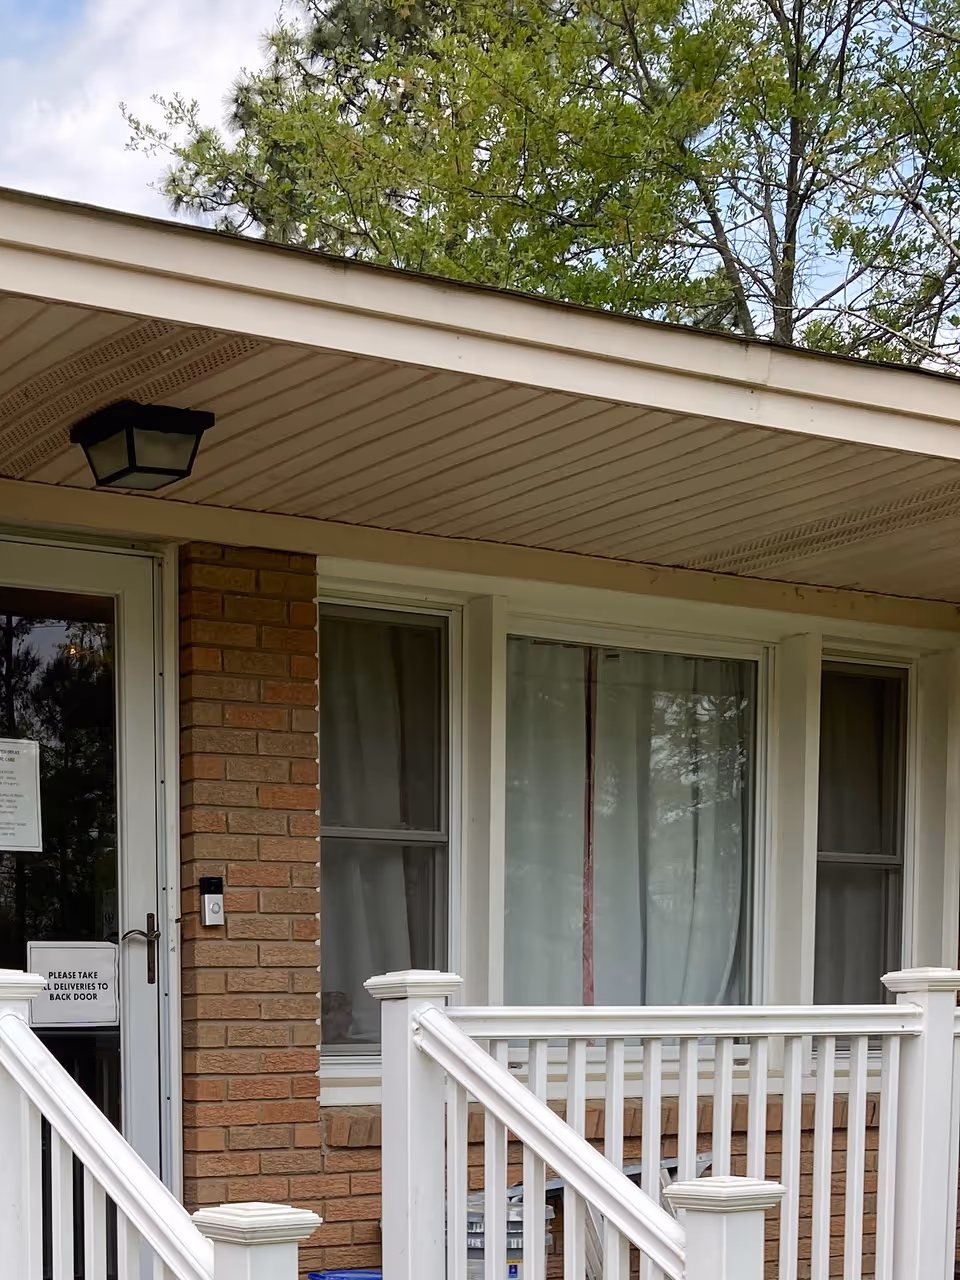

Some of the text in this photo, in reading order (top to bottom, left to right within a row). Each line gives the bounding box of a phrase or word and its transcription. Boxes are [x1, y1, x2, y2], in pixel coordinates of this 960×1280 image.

[48, 971, 98, 979] PLEASE TAKE
[54, 983, 96, 991] DELIVERIES
[98, 983, 109, 991] TO
[49, 993, 98, 1001] BACK DOOR
